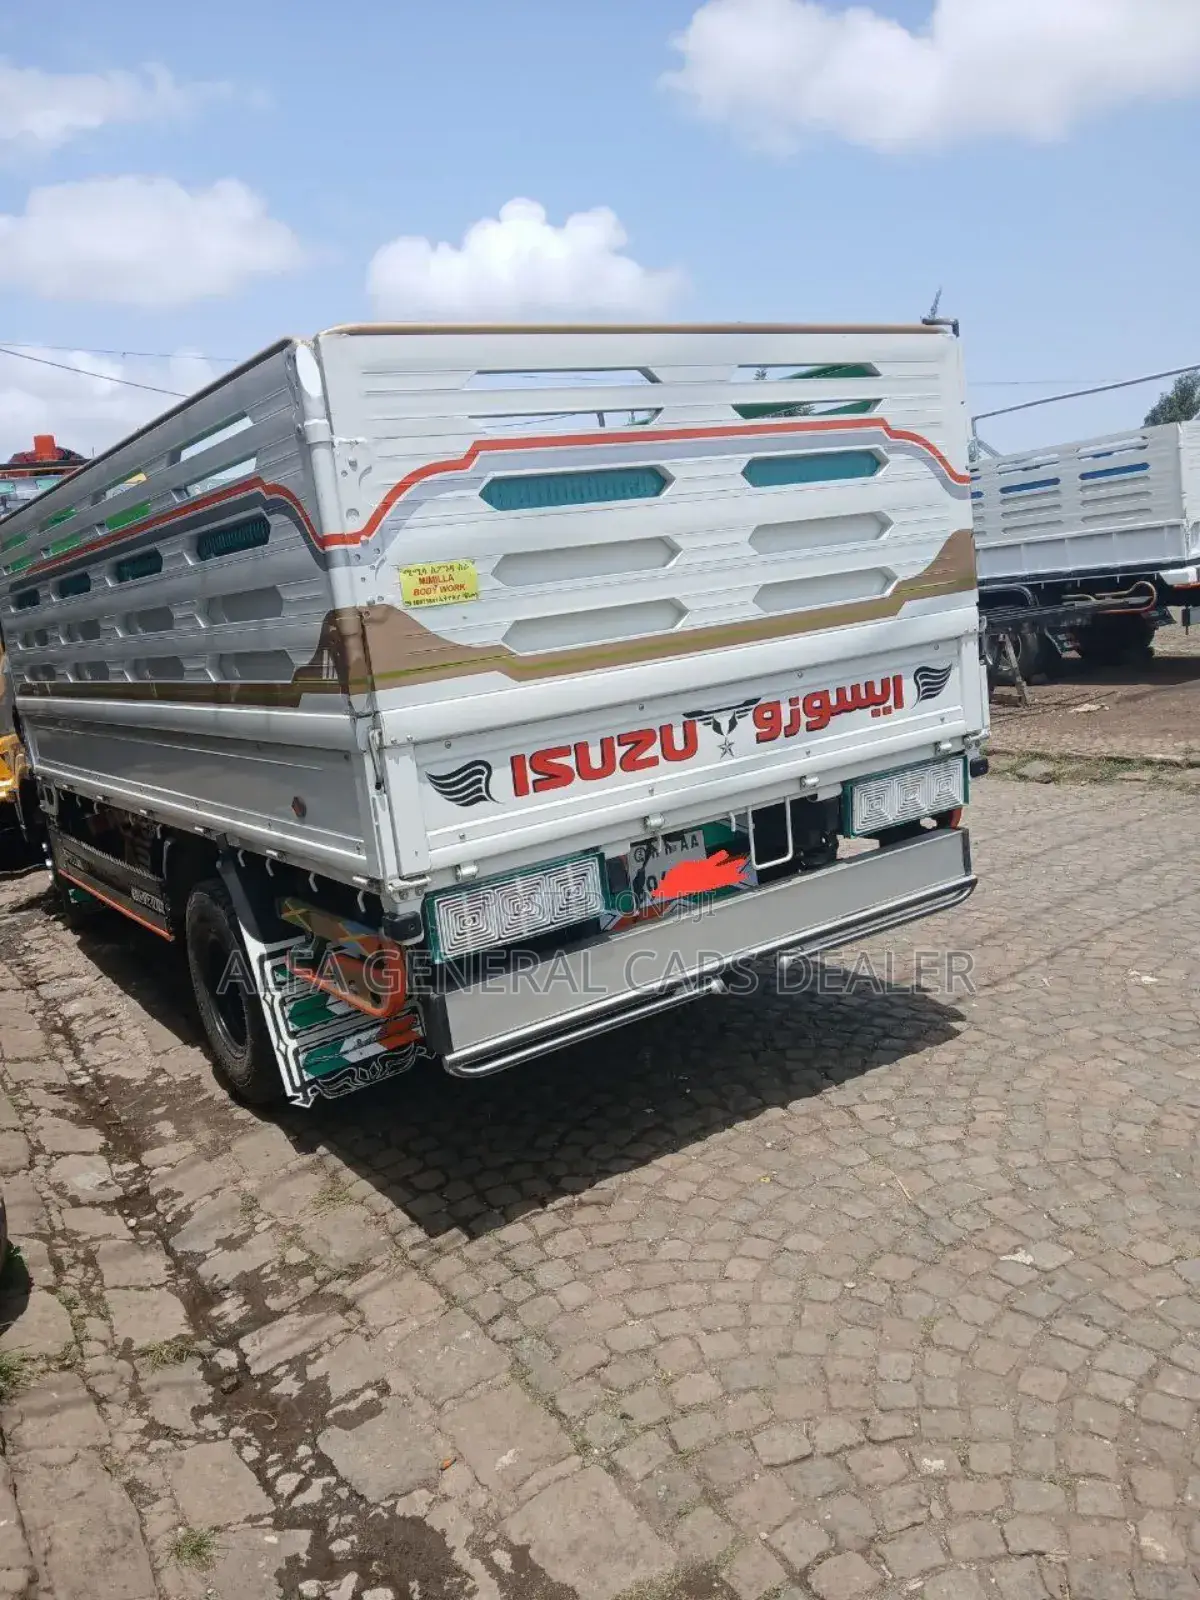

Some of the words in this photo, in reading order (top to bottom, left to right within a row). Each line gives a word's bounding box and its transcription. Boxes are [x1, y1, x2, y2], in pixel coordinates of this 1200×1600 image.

[413, 585, 438, 596] BODY
[440, 583, 466, 593] WORK
[510, 719, 699, 797] ISUZU
